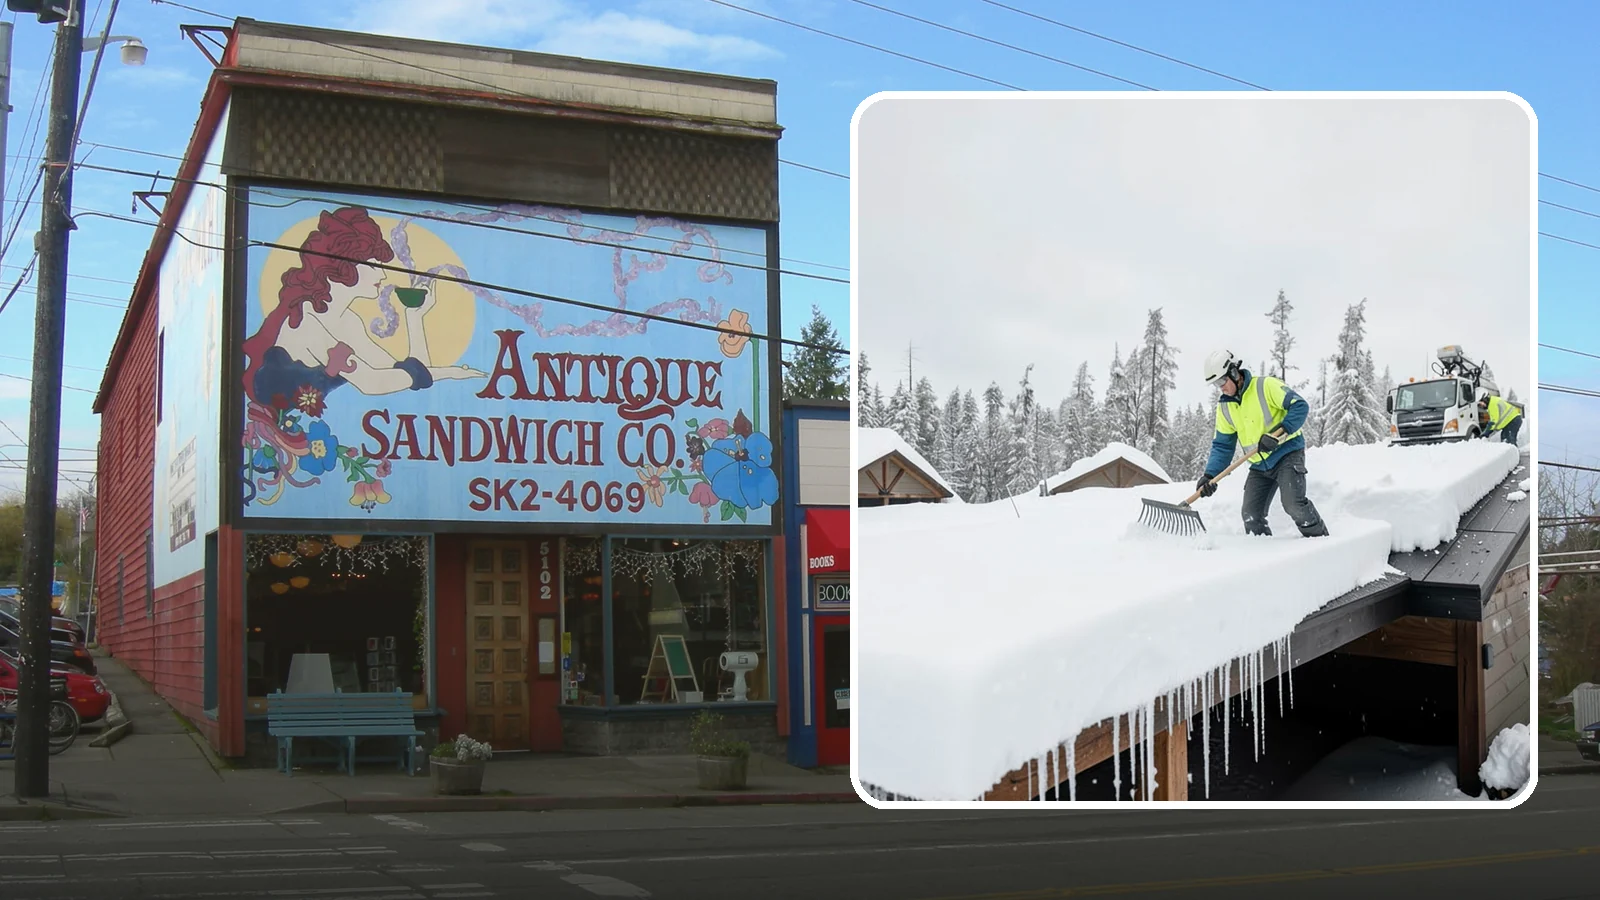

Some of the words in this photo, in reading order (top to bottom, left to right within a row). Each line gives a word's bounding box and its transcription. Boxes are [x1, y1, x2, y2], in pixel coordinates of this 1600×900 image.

[476, 329, 723, 420] ANTIQUE
[362, 409, 604, 467] SANDWICH
[616, 422, 685, 469] CO.
[468, 478, 646, 512] SK2-4069
[539, 541, 552, 600] 5102
[809, 555, 835, 569] BOOKS
